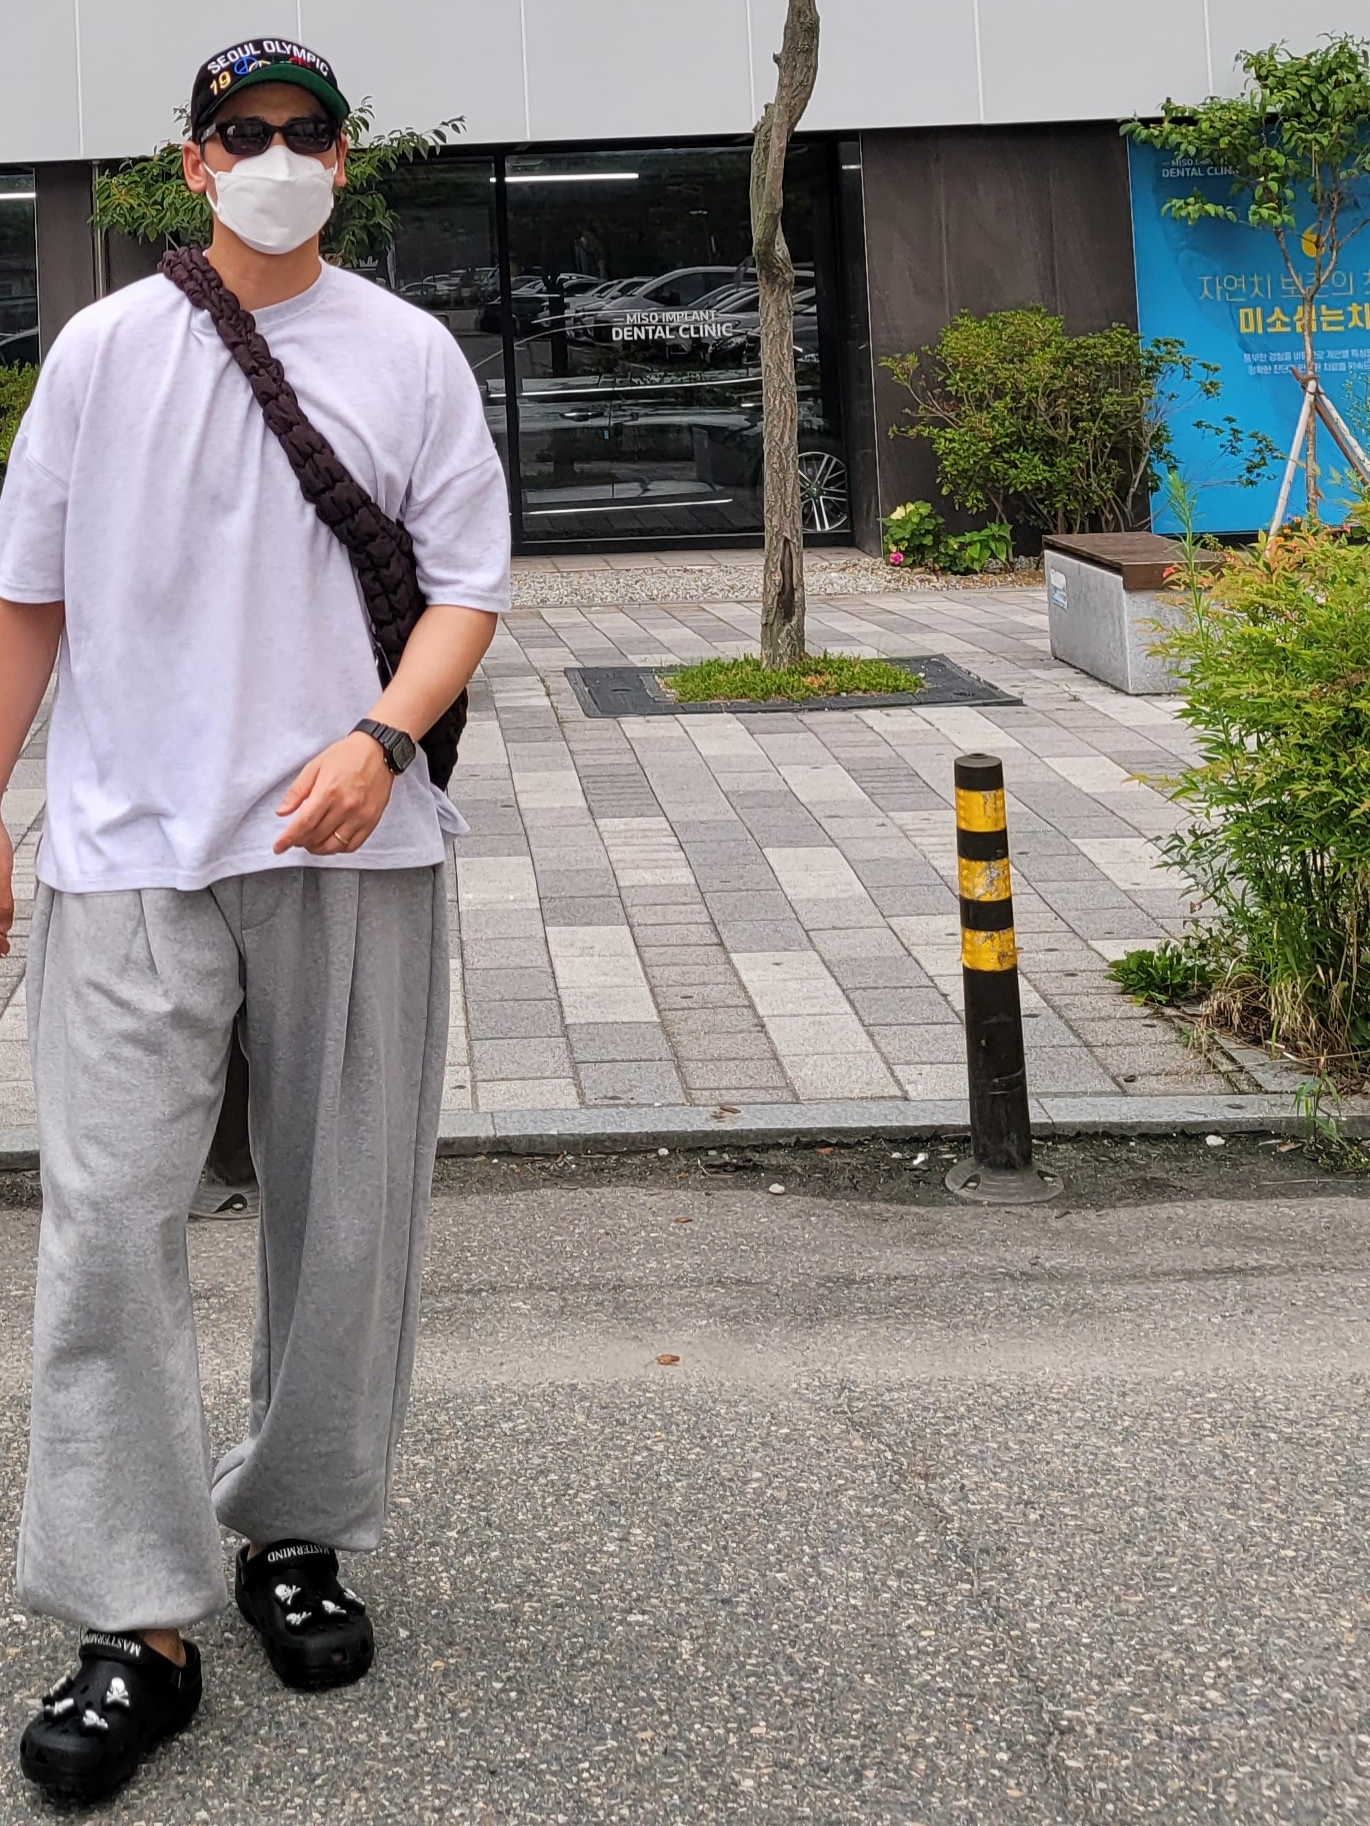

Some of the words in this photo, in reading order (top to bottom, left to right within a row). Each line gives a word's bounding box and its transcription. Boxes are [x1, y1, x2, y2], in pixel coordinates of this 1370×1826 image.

[207, 42, 261, 75] SEOUL
[262, 40, 329, 77] OLYMPIC
[210, 71, 231, 95] 19
[1162, 167, 1205, 178] DENTAL
[1197, 272, 1272, 302] 자연치
[626, 312, 659, 324] MISO
[662, 310, 717, 323] IMPLANT
[611, 326, 675, 341] DENTAL
[678, 322, 733, 338] CLINIC
